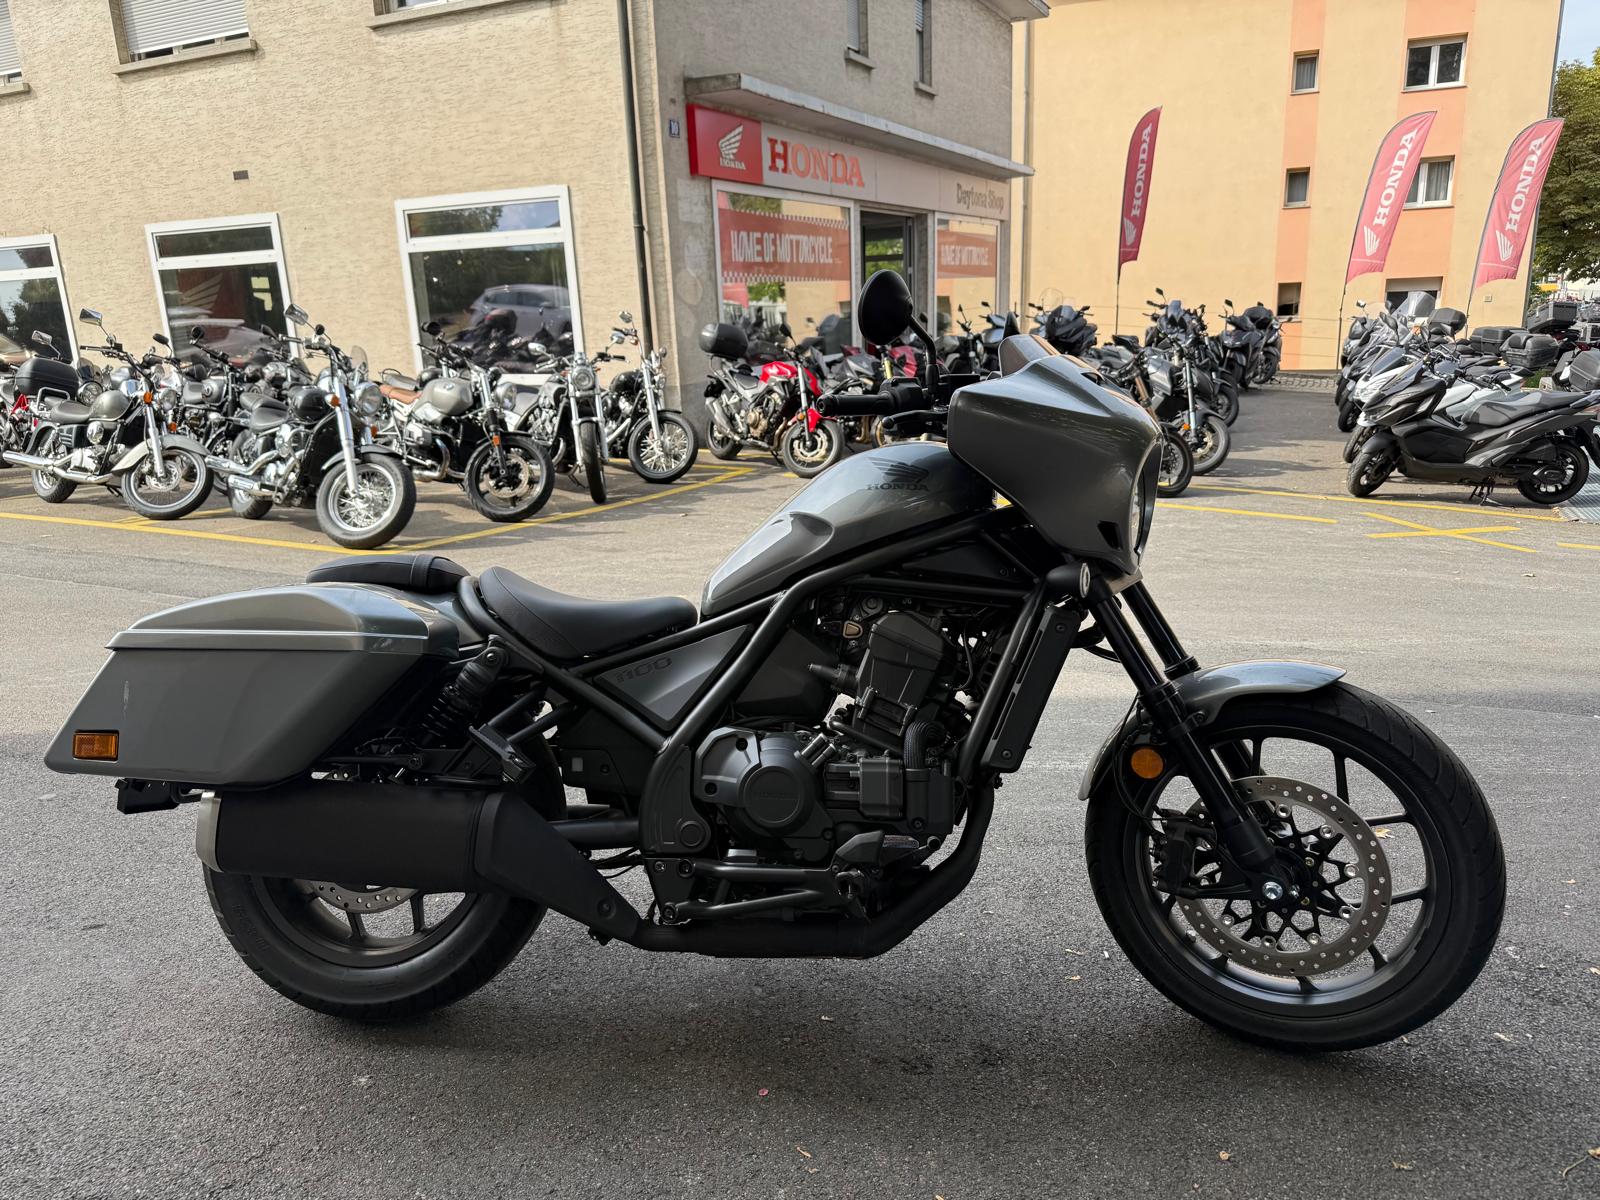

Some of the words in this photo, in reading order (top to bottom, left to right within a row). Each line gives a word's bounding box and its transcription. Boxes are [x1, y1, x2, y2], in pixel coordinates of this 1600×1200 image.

[719, 158, 746, 171] HONDA
[767, 137, 865, 187] HONDA
[1131, 123, 1153, 217] HONDA
[1373, 128, 1418, 226] HONDA
[1505, 135, 1547, 232] HONDA
[730, 230, 762, 262] HOME
[763, 232, 775, 263] OF
[866, 483, 929, 491] HONDA
